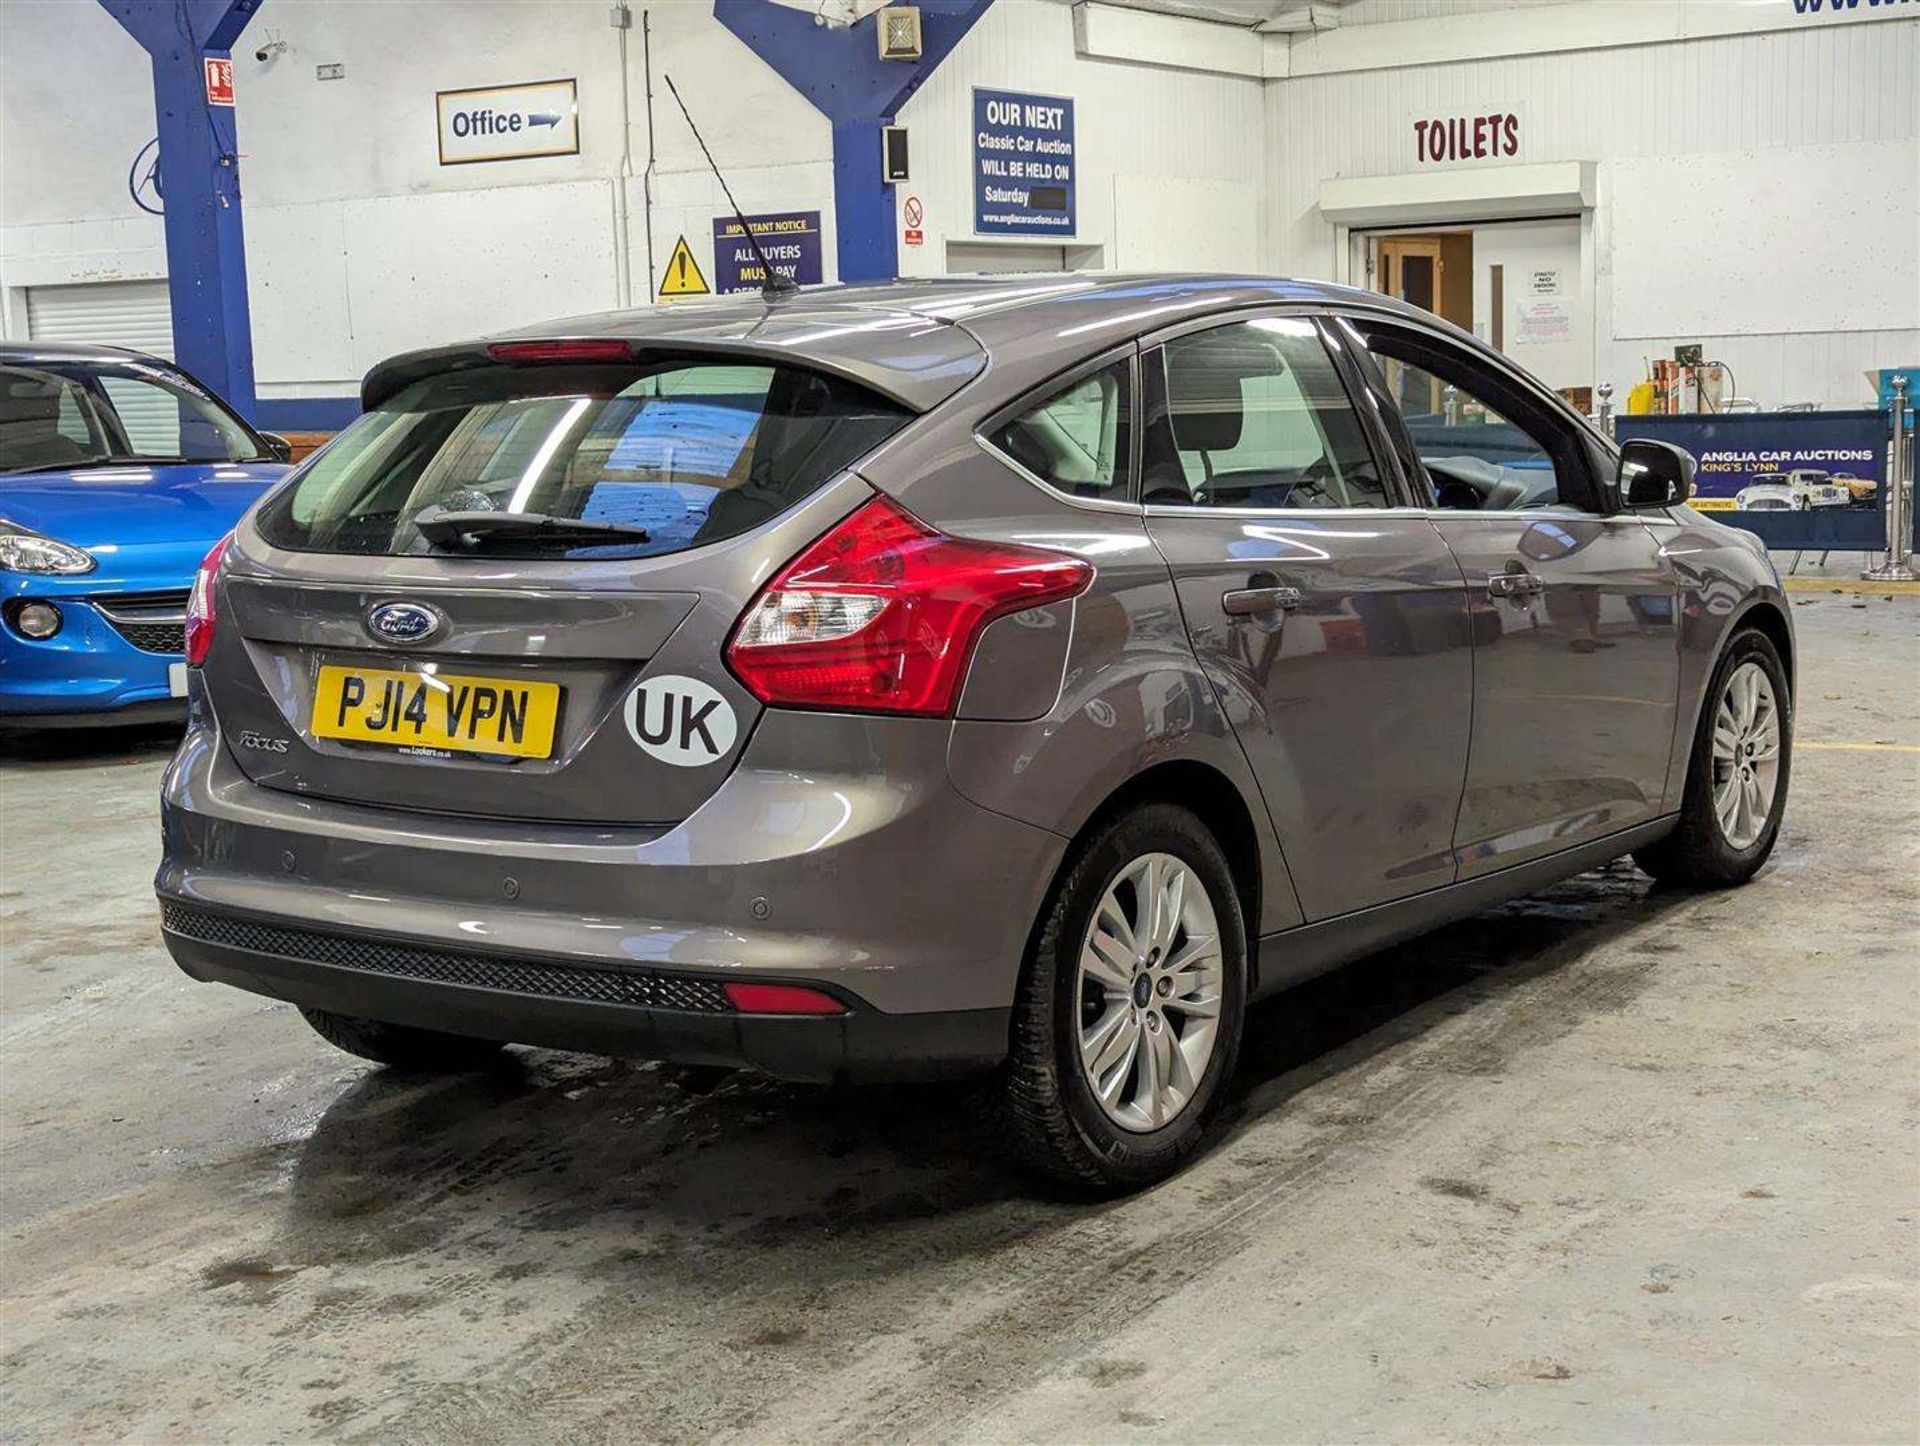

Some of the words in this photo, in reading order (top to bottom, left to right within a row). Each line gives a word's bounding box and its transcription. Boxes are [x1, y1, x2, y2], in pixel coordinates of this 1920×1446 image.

[453, 109, 522, 137] Office
[987, 101, 1020, 126] OUR
[1025, 105, 1064, 131] NEXT
[978, 132, 1015, 150] Classic
[1017, 135, 1034, 152] Car
[1036, 137, 1072, 154] Auction
[1414, 114, 1518, 162] TOILETS
[982, 159, 1007, 176] WILL
[1010, 162, 1023, 177] BE
[1026, 162, 1052, 179] HELD
[1054, 165, 1069, 180] ON
[985, 186, 1030, 207] Saturday
[775, 220, 807, 231] NOTICE
[735, 248, 756, 261] ALL
[741, 266, 768, 280] MUS
[1701, 452, 1757, 462] ANGLIA
[1759, 451, 1791, 462] CAR
[1794, 450, 1873, 461] AUCTIONS
[1701, 463, 1742, 472] KING'S
[1745, 462, 1779, 472] LYNN
[337, 676, 428, 734] PJ14
[447, 685, 528, 744] VPN
[636, 688, 721, 755] UK
